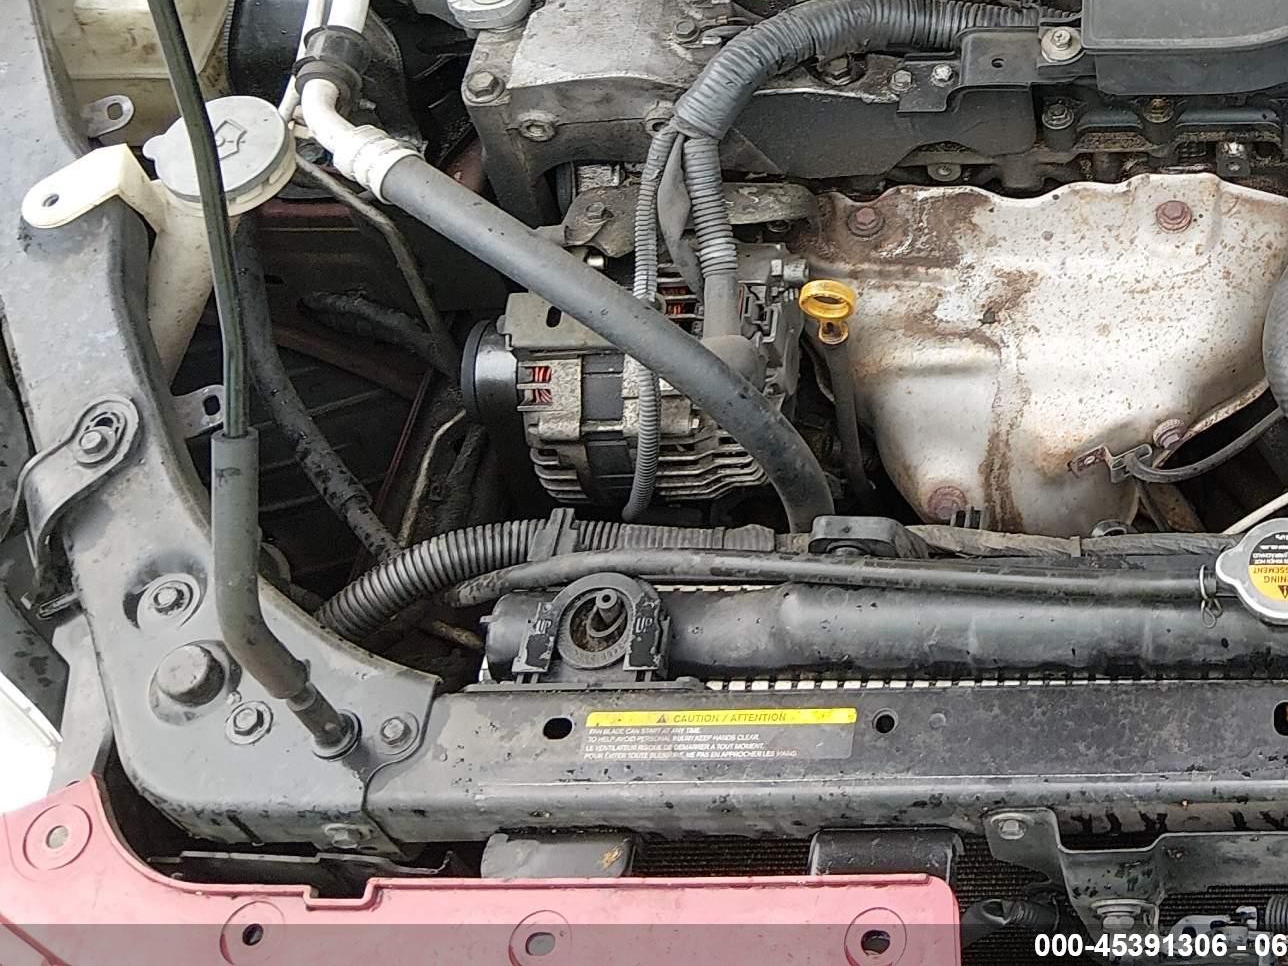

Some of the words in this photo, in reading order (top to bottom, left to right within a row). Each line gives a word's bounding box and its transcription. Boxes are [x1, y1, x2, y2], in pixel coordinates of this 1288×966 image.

[536, 619, 552, 635] UP
[635, 617, 652, 633] UP
[673, 714, 719, 723] CAUTION
[730, 713, 786, 722] ATTENTION
